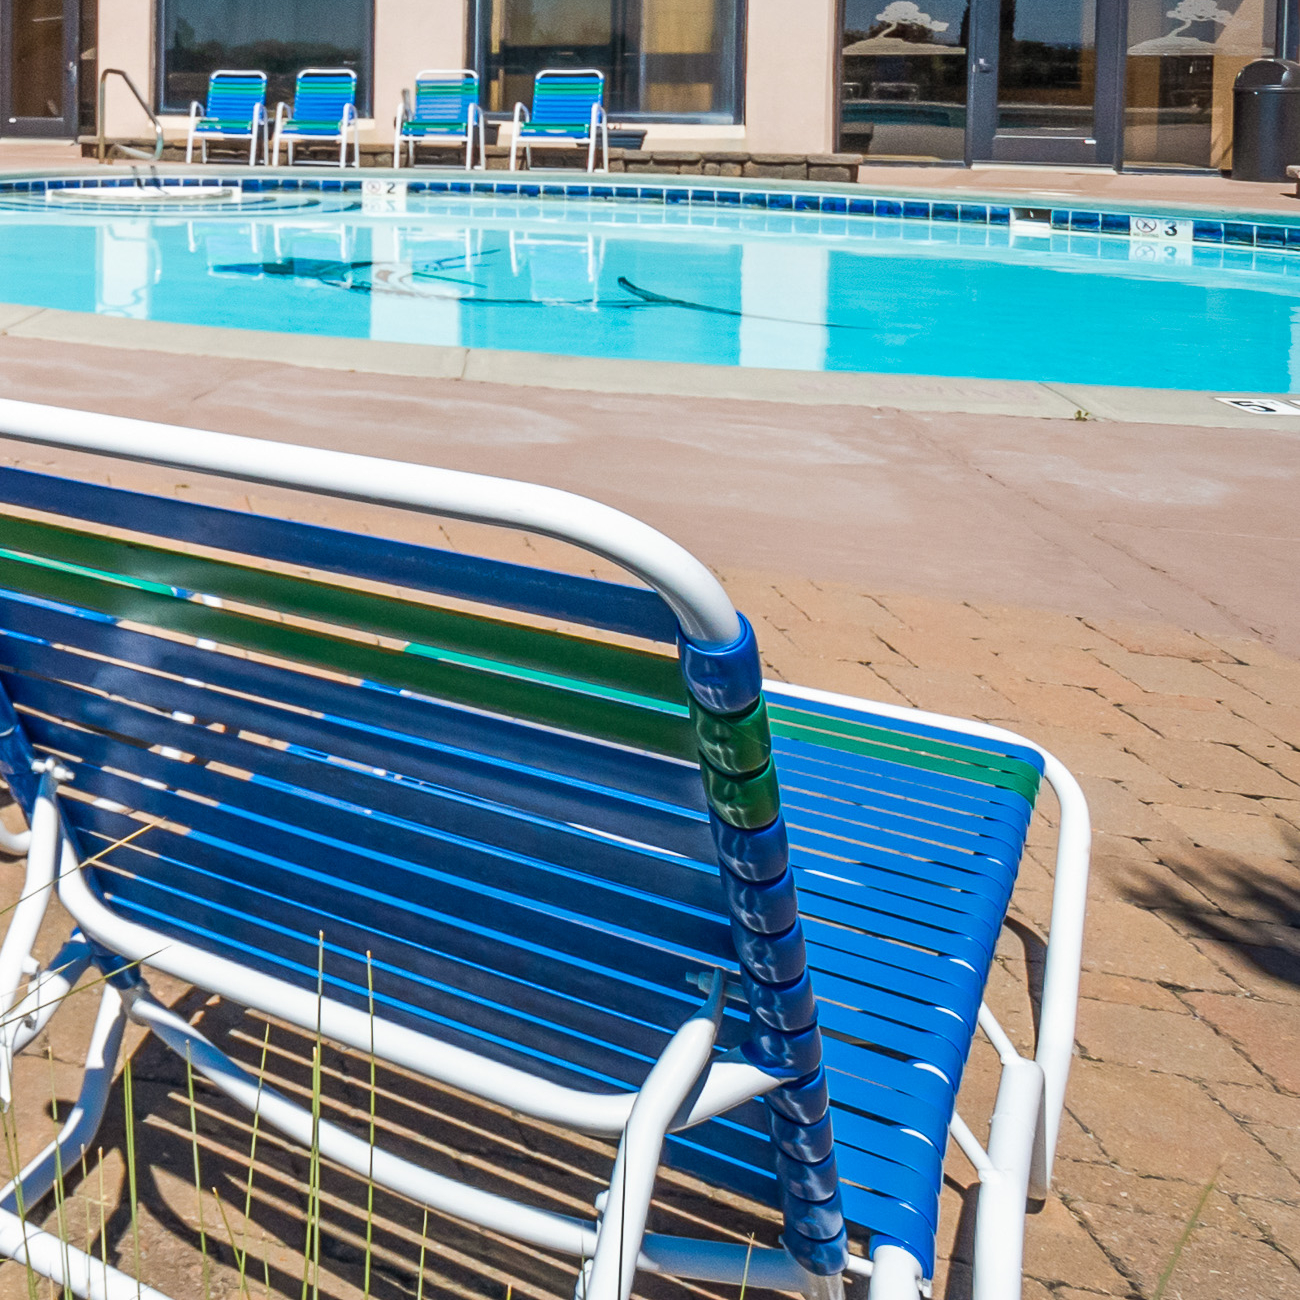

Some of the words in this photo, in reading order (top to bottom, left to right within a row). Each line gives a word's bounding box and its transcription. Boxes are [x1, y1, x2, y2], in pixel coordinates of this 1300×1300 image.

[386, 182, 396, 194] 2
[1164, 220, 1178, 237] 3
[1229, 401, 1277, 412] 5
